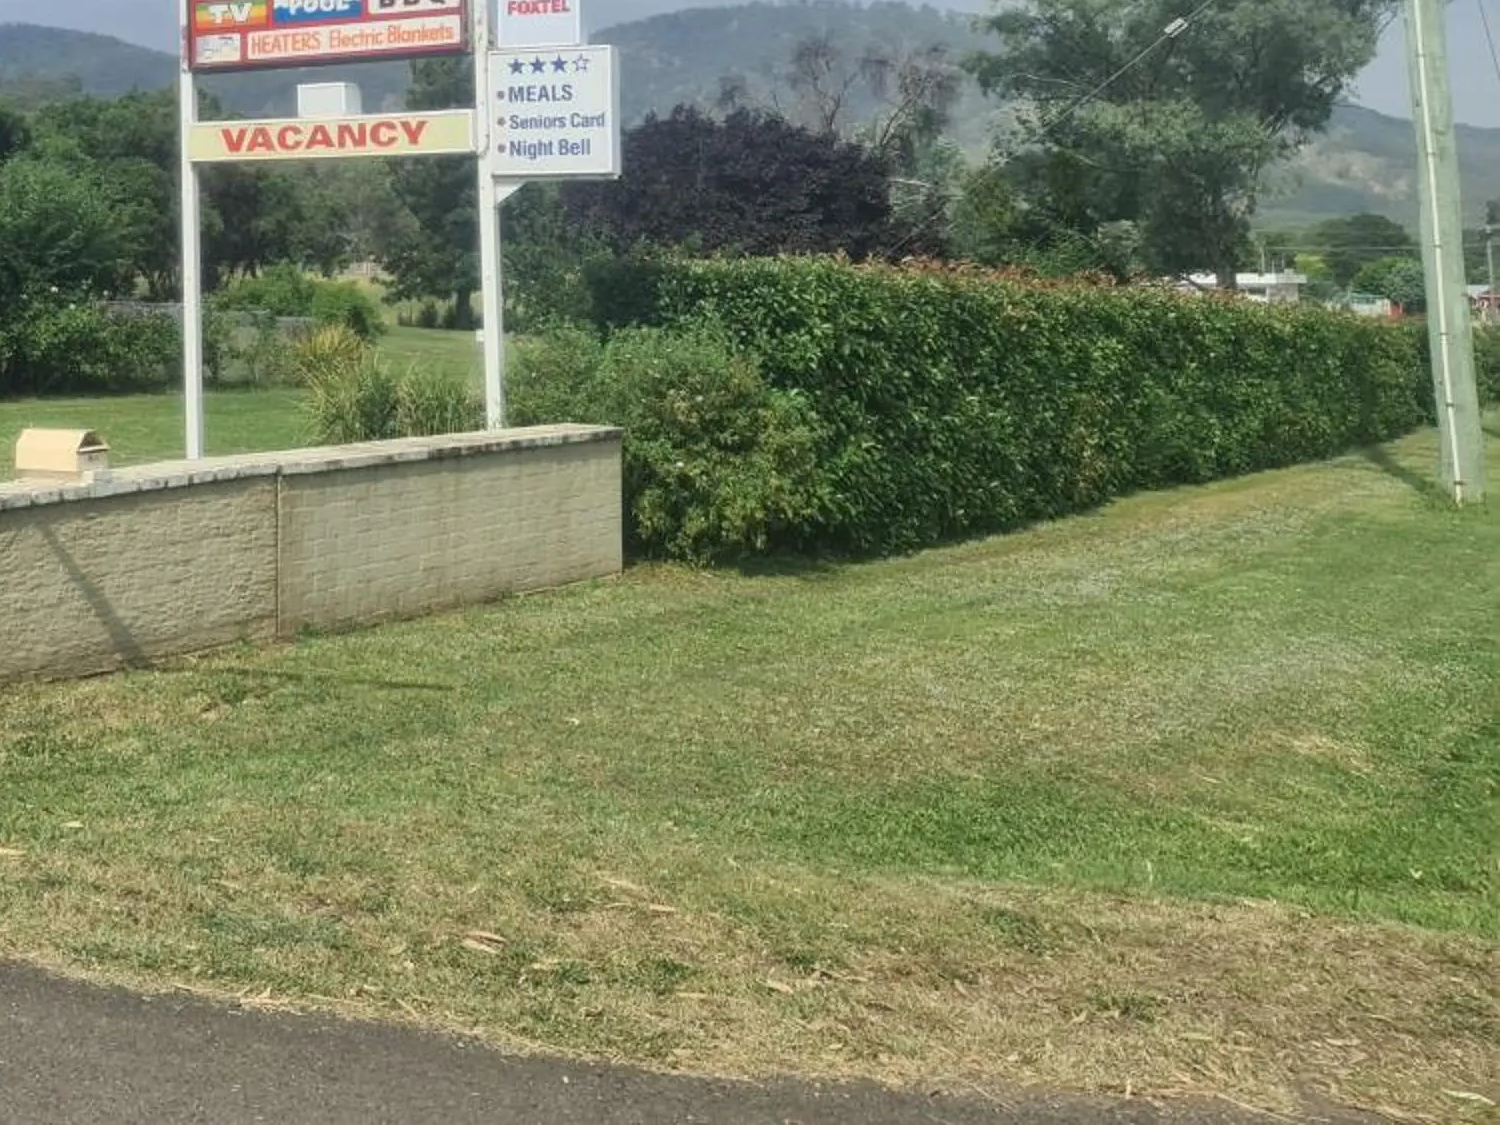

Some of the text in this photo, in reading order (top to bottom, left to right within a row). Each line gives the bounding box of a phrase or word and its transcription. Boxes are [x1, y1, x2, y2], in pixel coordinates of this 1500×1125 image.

[208, 2, 253, 25] TV
[251, 24, 454, 54] HEATERS Electric Blankets
[508, 84, 574, 102] MEALS
[509, 112, 605, 130] Seniors Card
[221, 120, 429, 152] VACANCY
[509, 138, 591, 160] Night Bell
